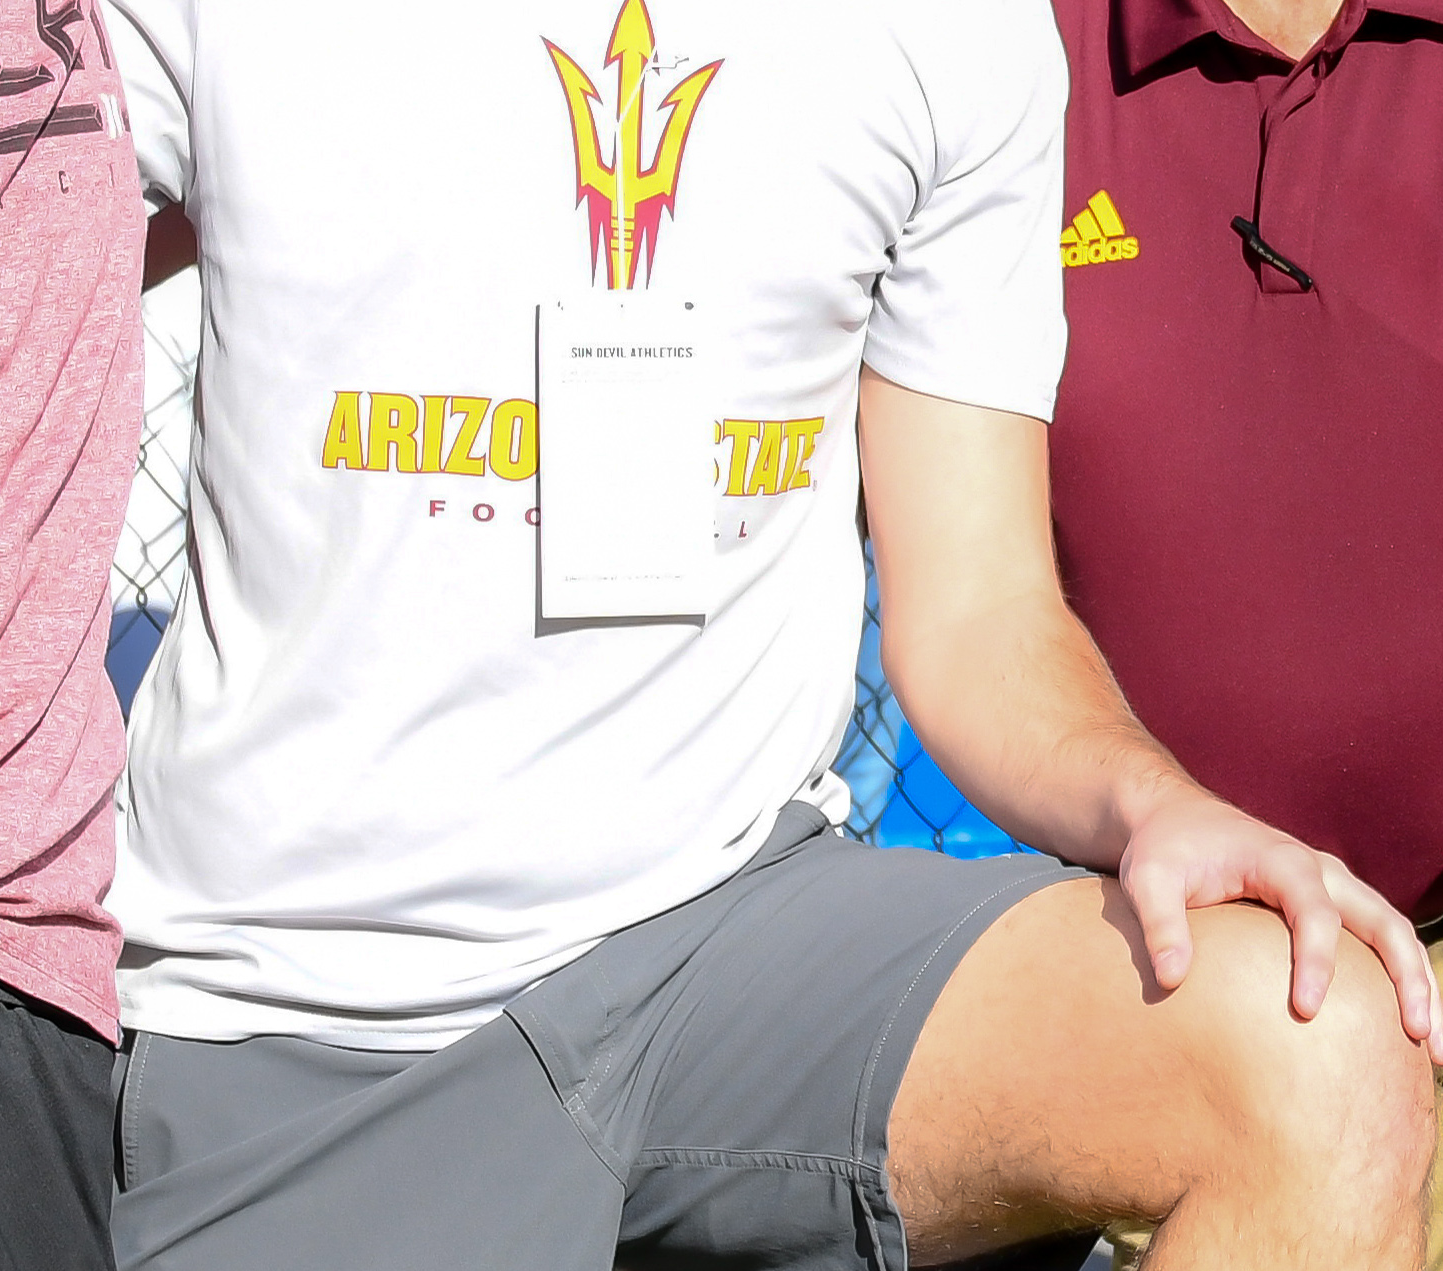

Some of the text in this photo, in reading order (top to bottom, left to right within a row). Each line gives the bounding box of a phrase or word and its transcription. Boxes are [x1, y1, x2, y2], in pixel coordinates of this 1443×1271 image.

[571, 346, 694, 359] SUN DEVIL ATHLETICS
[322, 390, 825, 496] ARIZO TATE
